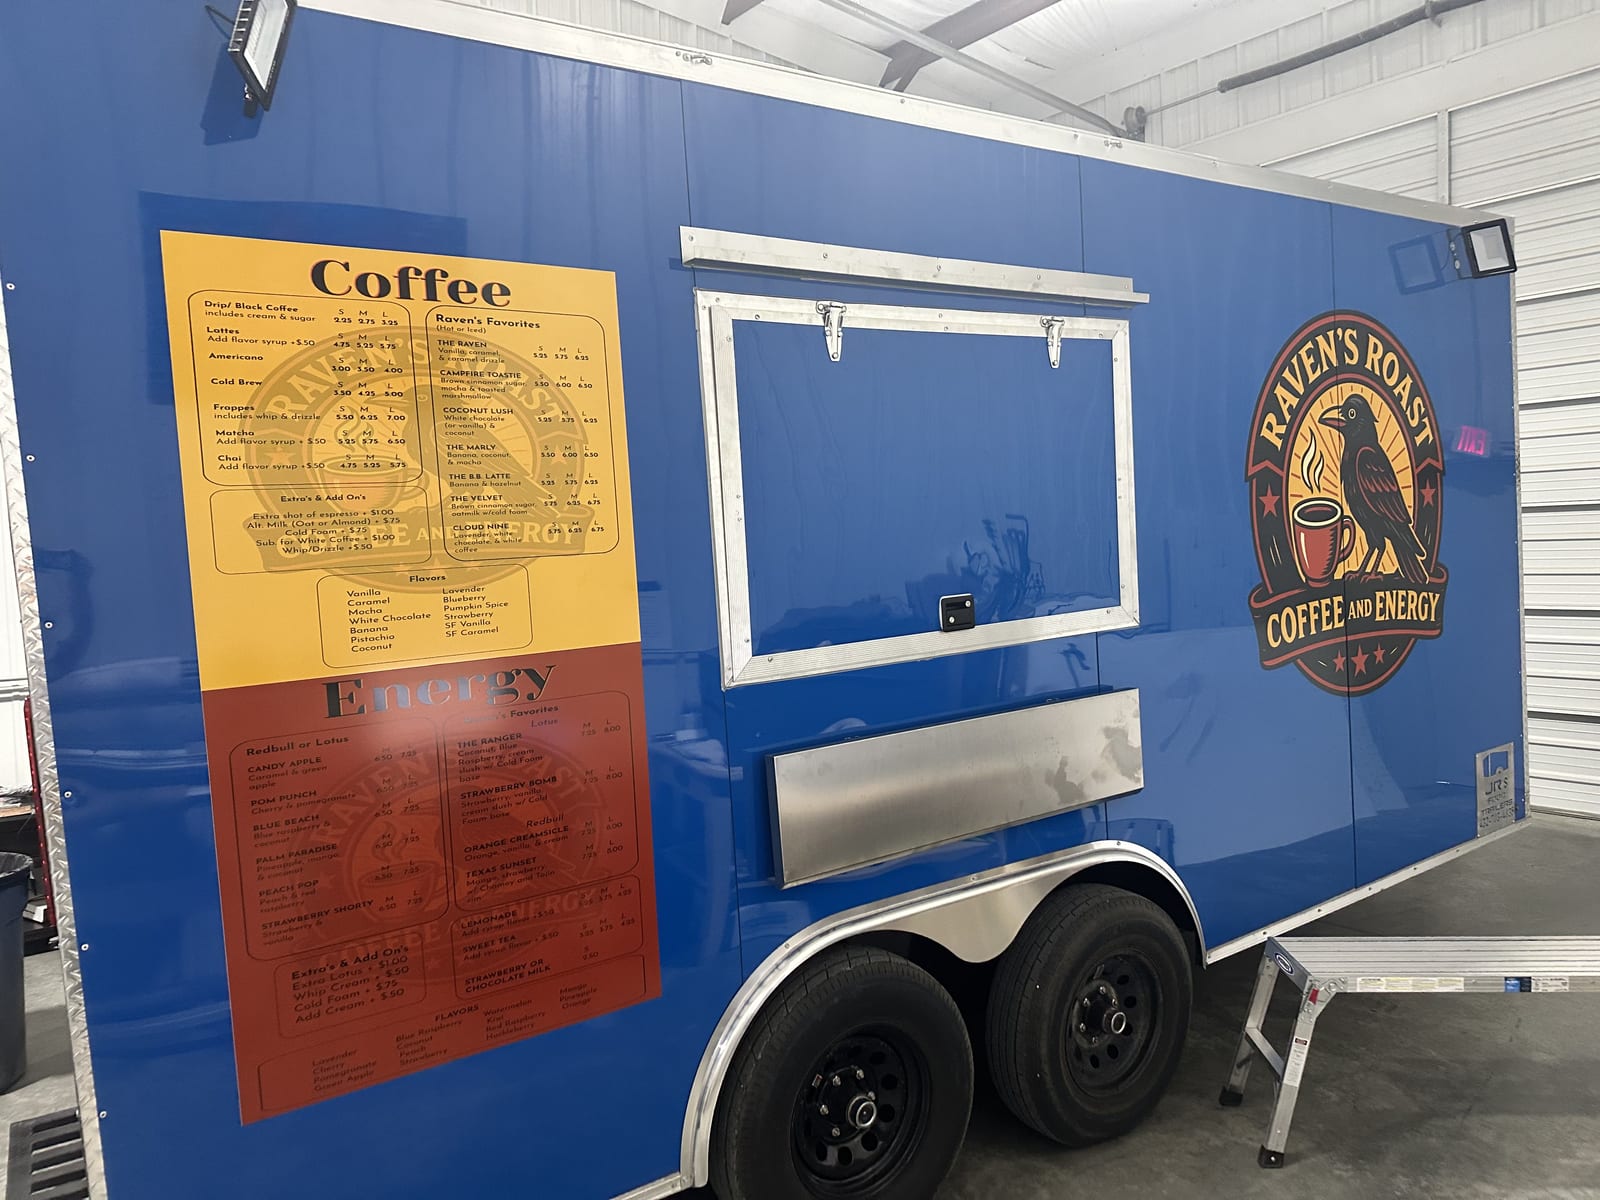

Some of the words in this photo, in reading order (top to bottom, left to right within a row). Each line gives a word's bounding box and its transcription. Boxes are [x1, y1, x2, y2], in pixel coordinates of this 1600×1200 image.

[310, 259, 511, 307] Coffee
[205, 310, 244, 318] includes
[266, 304, 298, 312] Coffee
[436, 314, 482, 324] Raven's
[487, 318, 541, 328] Favorites
[232, 336, 258, 344] flavor
[1260, 328, 1359, 450] RAVEN'S
[1365, 333, 1434, 447] ROAST
[213, 404, 255, 412] Frappes
[282, 545, 345, 554] Whip/Drizzle
[409, 575, 446, 583] Flavors
[348, 598, 390, 607] Caramel
[443, 595, 486, 603] Blueberry
[444, 604, 482, 612] Pumpkin
[444, 612, 493, 620] Strawberry
[349, 617, 379, 625] White
[383, 613, 431, 622] Chocolate
[1267, 595, 1344, 648] COFFEE
[1347, 598, 1372, 621] AND
[1374, 590, 1439, 622] ENERGY
[350, 626, 388, 634] Banana
[351, 634, 395, 643] Pistachio
[460, 627, 499, 635] Caramel
[351, 644, 393, 652] Coconut
[322, 664, 556, 718] Energy
[511, 706, 558, 717] Favorites
[531, 719, 558, 728] Lotus
[246, 742, 294, 756] Redbull
[316, 736, 349, 746] Lotus
[457, 740, 478, 748] THE
[480, 733, 522, 745] RANGER
[247, 762, 285, 773] CANDY
[289, 756, 322, 767] APPLE
[460, 782, 526, 799] STRAWBERRY
[529, 776, 557, 786] BOMB
[250, 797, 275, 807] POM
[279, 790, 317, 802] PUNCH
[253, 821, 280, 831] BLUE
[284, 814, 320, 825] BEACH
[526, 814, 564, 828] Redbull
[464, 840, 506, 853] ORANGE
[510, 826, 569, 843] CREAMSICLE
[256, 854, 284, 864] PALM
[289, 844, 337, 857] PARADISE
[466, 867, 497, 877] TEXAS
[500, 857, 537, 870] SUNSET
[259, 885, 294, 897] PEACH
[298, 879, 319, 888] POP
[262, 909, 330, 929] STRAWBERRY
[334, 900, 374, 913] SHORTY
[461, 911, 517, 929] LEMONADE
[463, 941, 495, 953] SWEET
[499, 935, 516, 943] TEA
[292, 963, 335, 979] Extra's
[354, 953, 378, 964] Add
[382, 945, 409, 957] On's
[292, 977, 326, 990] Extra
[330, 968, 362, 982] Lotus
[465, 963, 527, 985] STRAWBERRY
[530, 959, 544, 967] OR
[466, 973, 524, 993] CHOCOLATE
[528, 966, 551, 976] MILK
[294, 988, 326, 1000] Whip
[331, 976, 370, 990] Cream
[294, 1000, 322, 1012] Cold
[328, 990, 360, 1003] Foam
[296, 1011, 320, 1024] Add
[325, 1000, 365, 1014] Cream
[435, 1005, 479, 1021] FLAVORS
